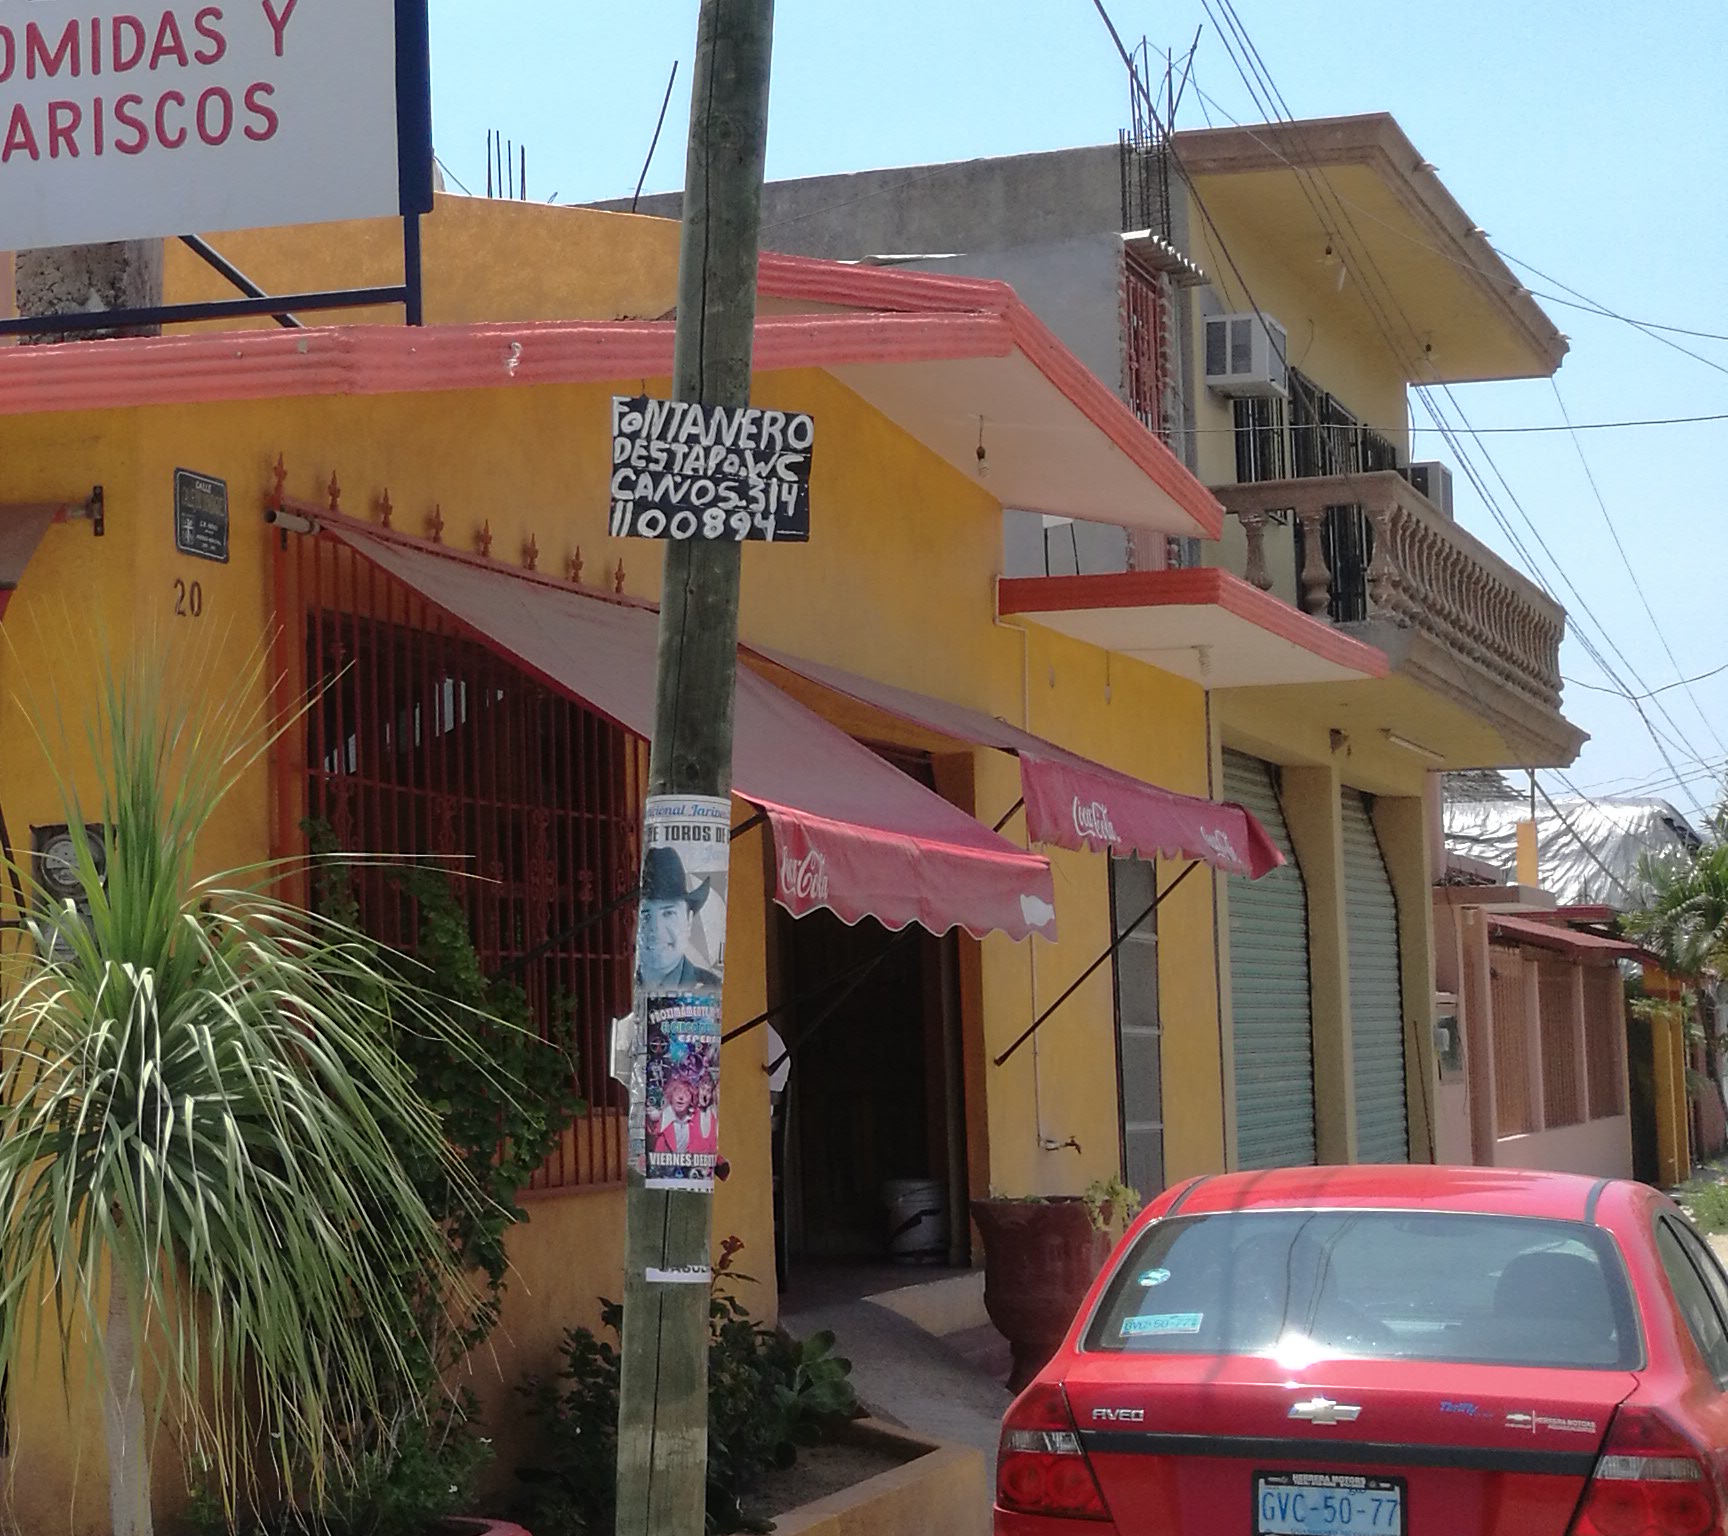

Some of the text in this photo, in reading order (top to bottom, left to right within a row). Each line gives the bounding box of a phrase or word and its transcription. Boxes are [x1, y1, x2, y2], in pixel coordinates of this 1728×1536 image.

[174, 578, 202, 617] 20
[664, 825, 712, 842] TOROS
[648, 1152, 692, 1167] VIERNES
[1092, 1408, 1144, 1422] AVEO
[1262, 1492, 1399, 1527] GVC-50-77
